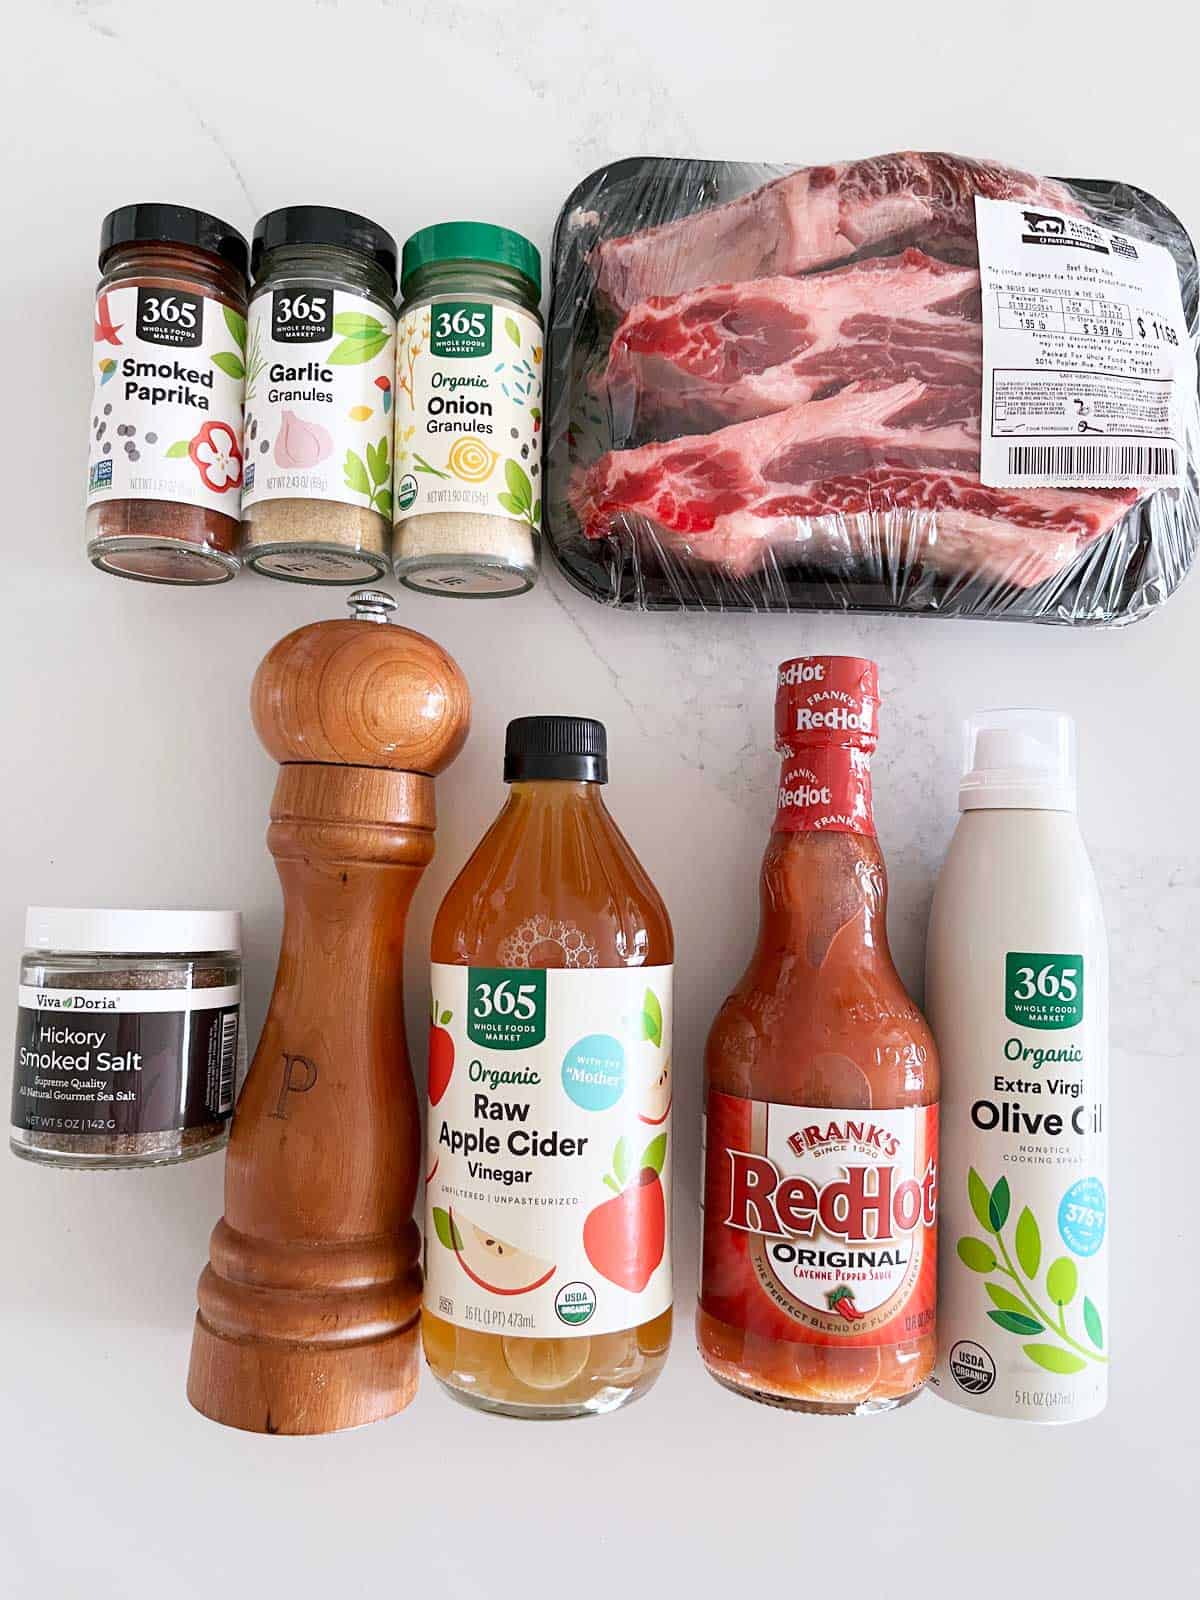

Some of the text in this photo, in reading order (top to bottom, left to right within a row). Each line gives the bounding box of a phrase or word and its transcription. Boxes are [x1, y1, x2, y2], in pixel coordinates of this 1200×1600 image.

[142, 296, 197, 328] 365
[276, 294, 327, 323] 365
[143, 326, 168, 334] WHOLE
[435, 308, 486, 338] 365
[1136, 316, 1147, 340] $
[122, 358, 214, 389] Smoked
[269, 362, 334, 383] Garlic
[431, 372, 489, 392] Organic
[125, 382, 210, 411] Paprika
[268, 387, 334, 404] Granules
[428, 395, 493, 417] Onion
[426, 419, 493, 434] Granules
[778, 785, 831, 809] RedHot
[1013, 964, 1078, 1002] 365
[36, 994, 61, 1008] Viva
[473, 979, 537, 1020] 365
[1014, 1004, 1077, 1014] WHOLE FOODS
[473, 1023, 536, 1033] WHOLE FOODS
[1028, 1014, 1065, 1022] MARKET
[40, 1026, 107, 1048] Hickory
[485, 1032, 521, 1042] MARKET
[20, 1047, 142, 1072] Smoked Salt
[1003, 1037, 1084, 1070] Organic
[34, 1076, 107, 1090] Supreme Quality
[468, 1059, 541, 1090] Organic
[27, 1088, 53, 1100] Natural
[53, 1090, 95, 1102] Gourmet
[96, 1090, 115, 1101] Sea
[116, 1090, 136, 1101] Salt
[266, 1052, 318, 1120] P
[994, 1075, 1087, 1098] Extra Virgi
[473, 1093, 530, 1122] Raw
[970, 1099, 1063, 1136] Olive
[25, 1116, 116, 1129] NET WT 5 OZ 142 G
[439, 1120, 589, 1157] Apple Cider
[787, 1119, 901, 1157] FRANK'S
[813, 1144, 879, 1159] SINCE 1920
[1002, 1154, 1052, 1165] COOKING
[467, 1160, 533, 1186] Vinegar
[441, 1184, 579, 1206] UNFILTERED UNPASTEURIZED
[723, 1148, 937, 1244] RedHot
[772, 1244, 908, 1269] ORIGINAL
[793, 1265, 833, 1281] CAYENNE
[835, 1268, 867, 1281] PEPPER
[564, 1292, 588, 1304] USDA
[753, 1255, 769, 1281] THE
[766, 1281, 808, 1322] PERFECT
[810, 1318, 850, 1333] BLEND
[852, 1320, 868, 1332] OF
[464, 1304, 473, 1320] 16
[474, 1306, 483, 1322] FL
[959, 1351, 985, 1368] USDA
[955, 1365, 988, 1383] ORGANIC
[1015, 1390, 1021, 1405] 5
